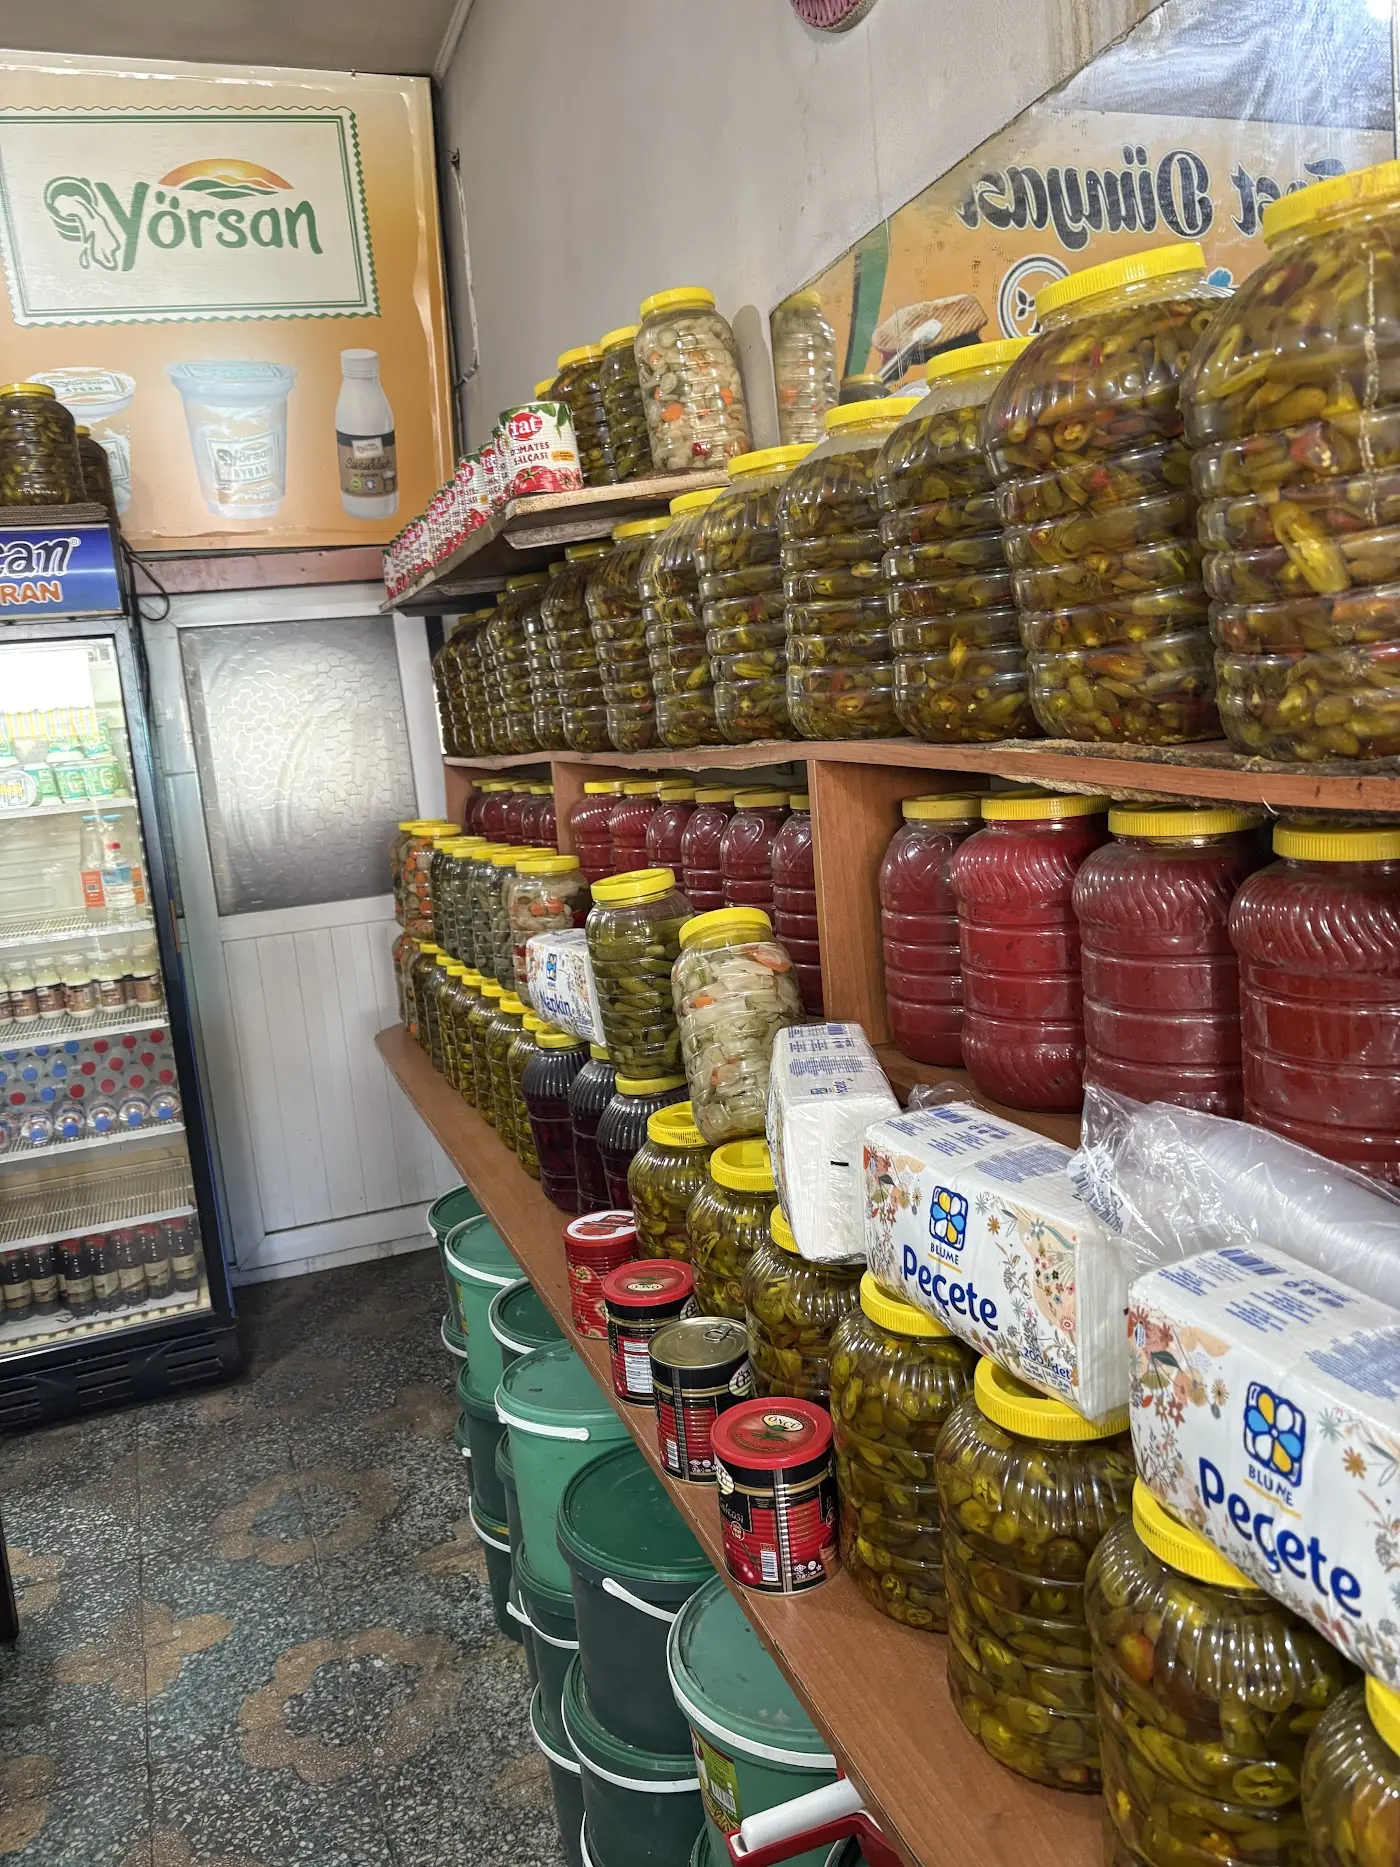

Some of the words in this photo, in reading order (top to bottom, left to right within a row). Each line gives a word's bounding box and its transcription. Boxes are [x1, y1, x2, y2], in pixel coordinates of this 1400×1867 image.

[95, 181, 323, 272] Yörsan
[509, 416, 541, 436] tat
[0, 580, 63, 606] RAN
[540, 989, 573, 1018] Napkin
[930, 1242, 959, 1265] BLUME
[903, 1244, 998, 1331] Peçete
[1022, 1347, 1044, 1365] 200
[768, 1415, 801, 1431] ÖNCÜ
[1199, 1456, 1361, 1618] Peçete
